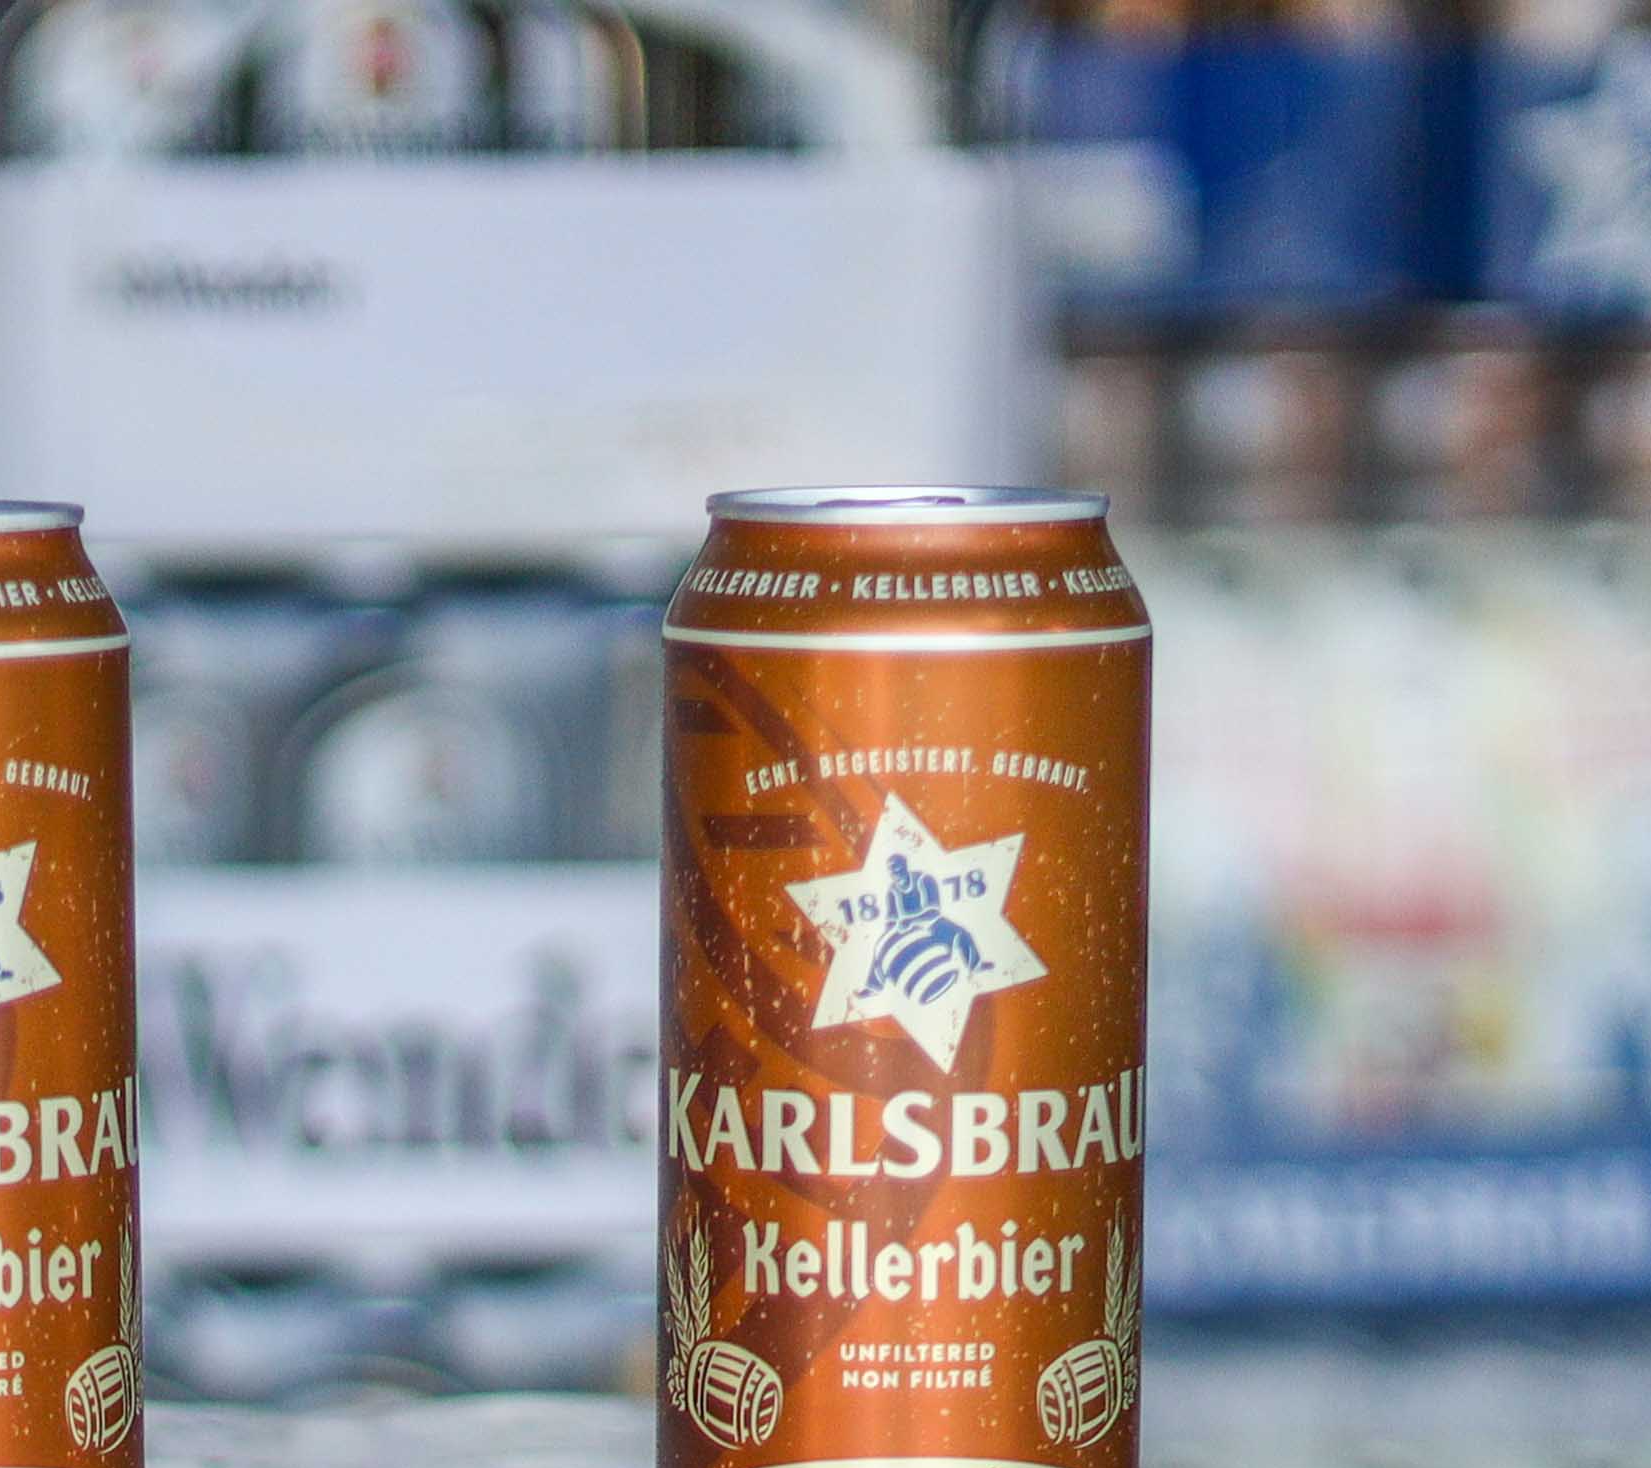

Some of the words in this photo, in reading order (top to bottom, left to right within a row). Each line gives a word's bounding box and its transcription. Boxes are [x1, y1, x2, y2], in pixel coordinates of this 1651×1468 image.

[852, 573, 1039, 599] KELLERBIER
[6, 759, 91, 801] GEBRAUT.
[746, 763, 807, 795] ECHT.
[819, 749, 978, 778] BEGEISTERT.
[993, 753, 1088, 794] GEBRAUT.
[668, 1066, 1144, 1178] KARLSBRÄU
[743, 1220, 1085, 1301] Kellerbier
[841, 1343, 995, 1363] UNFILTERED
[842, 1368, 897, 1388] NON
[910, 1364, 992, 1388] FILTRÉ
